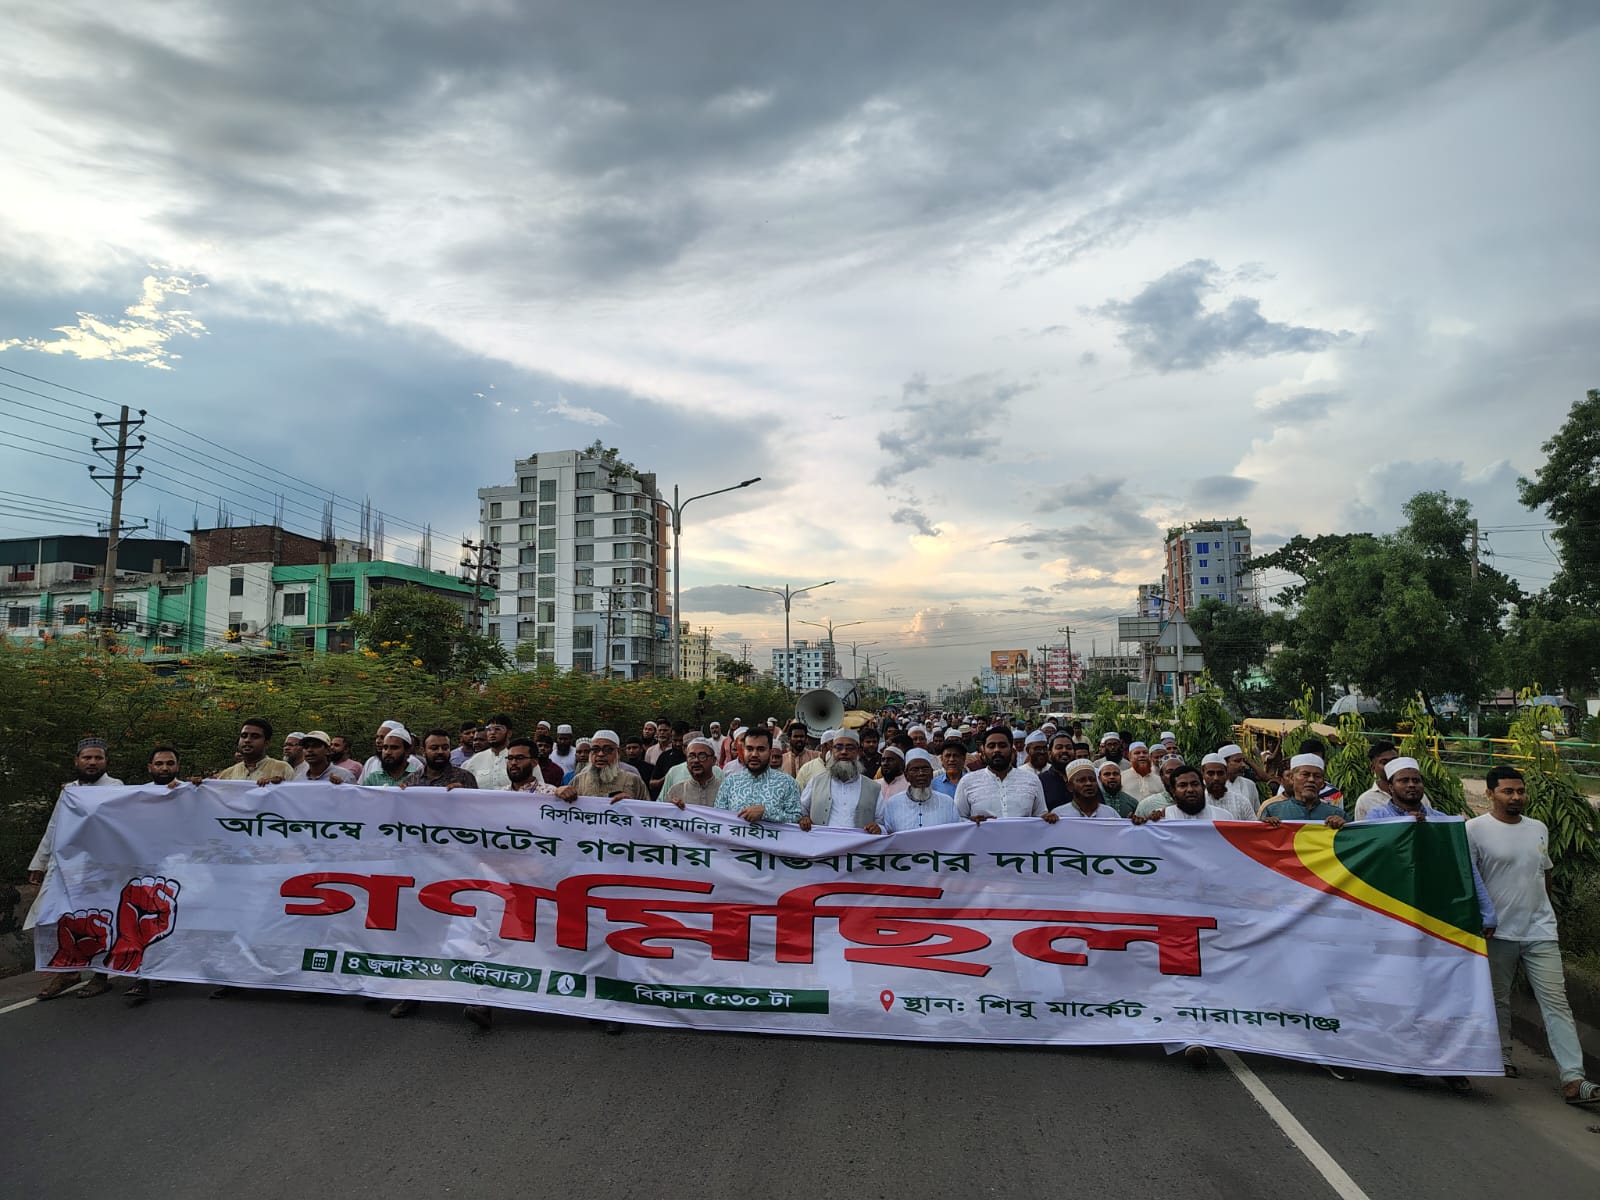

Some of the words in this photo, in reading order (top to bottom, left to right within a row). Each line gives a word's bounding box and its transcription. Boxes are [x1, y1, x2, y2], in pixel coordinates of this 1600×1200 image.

[216, 813, 366, 841] অবিলম্বে
[378, 821, 562, 857] গণভোটের
[577, 838, 717, 868] গণরায়
[987, 846, 1164, 876] দাবিতে
[729, 823, 780, 841] রাহীম
[281, 872, 1218, 977] গণমিছিল
[348, 957, 360, 969] ৪
[449, 962, 533, 988] (শনিবার)
[634, 984, 696, 1004] বিকাল
[703, 992, 760, 1006] ৫:৩০
[768, 990, 793, 1007] টা
[976, 994, 1037, 1020] শিবু
[1173, 1006, 1341, 1034] নারায়ণগঞ্জ
